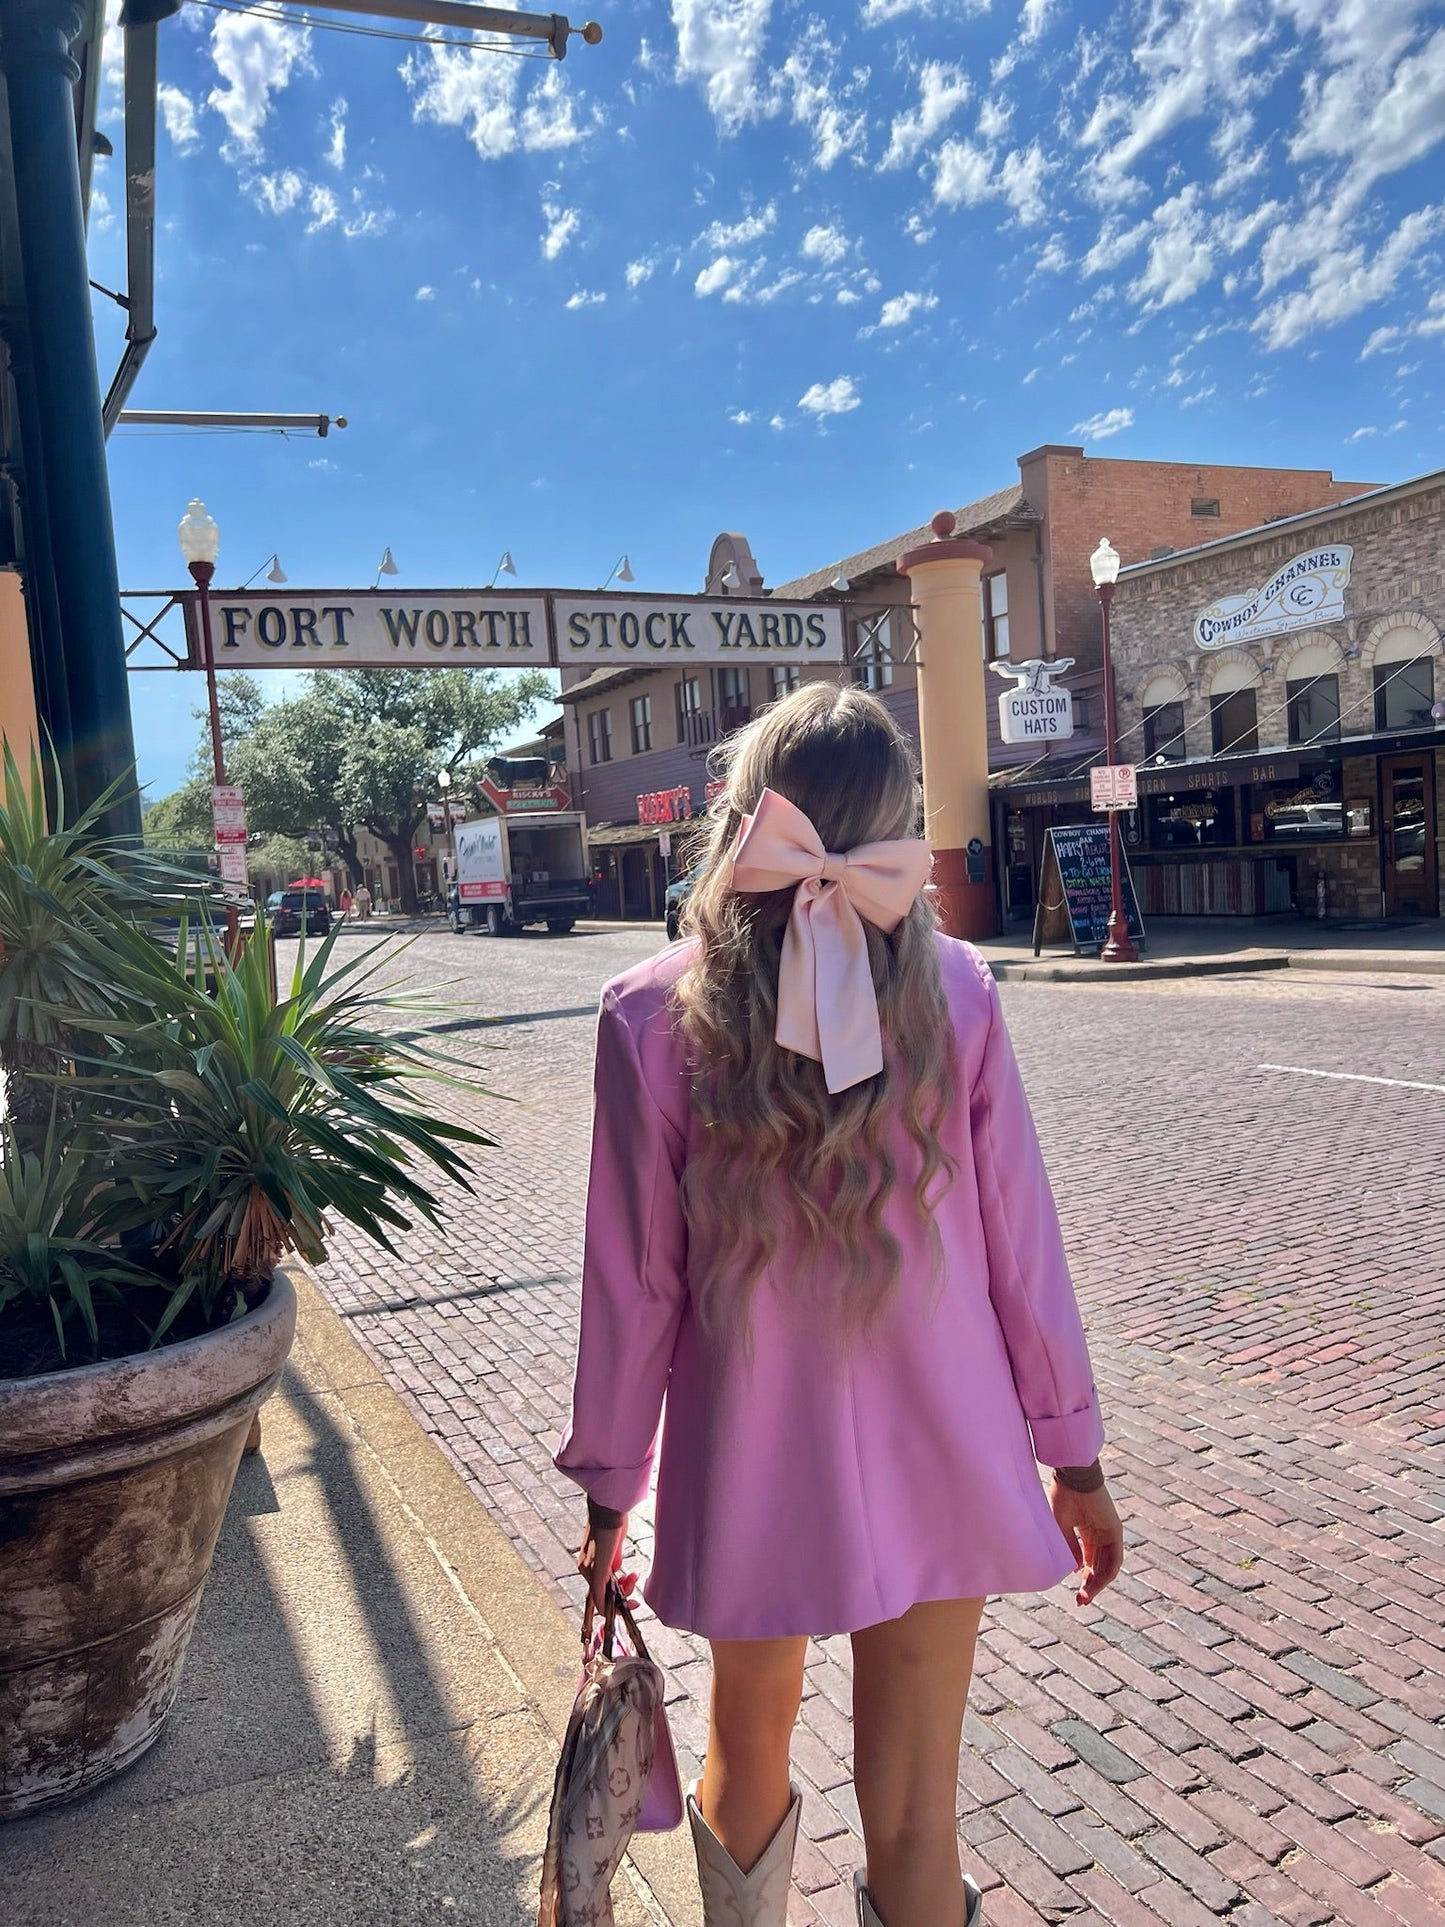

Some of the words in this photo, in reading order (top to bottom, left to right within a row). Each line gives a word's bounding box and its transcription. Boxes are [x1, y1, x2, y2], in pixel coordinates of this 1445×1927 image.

[1199, 600, 1260, 642] COWBOY
[1265, 552, 1341, 601] CHANNEL
[220, 606, 354, 651] FORT
[379, 607, 534, 651] WORTH
[567, 611, 695, 651] STOCK
[710, 611, 827, 651] YARDS
[1011, 697, 1067, 717] CUSTOM
[1024, 717, 1058, 735] HATS
[1188, 770, 1229, 789] SPORTS
[1252, 765, 1276, 780] BAR
[1053, 829, 1081, 839] COWBOY
[1080, 836, 1093, 844] BAR
